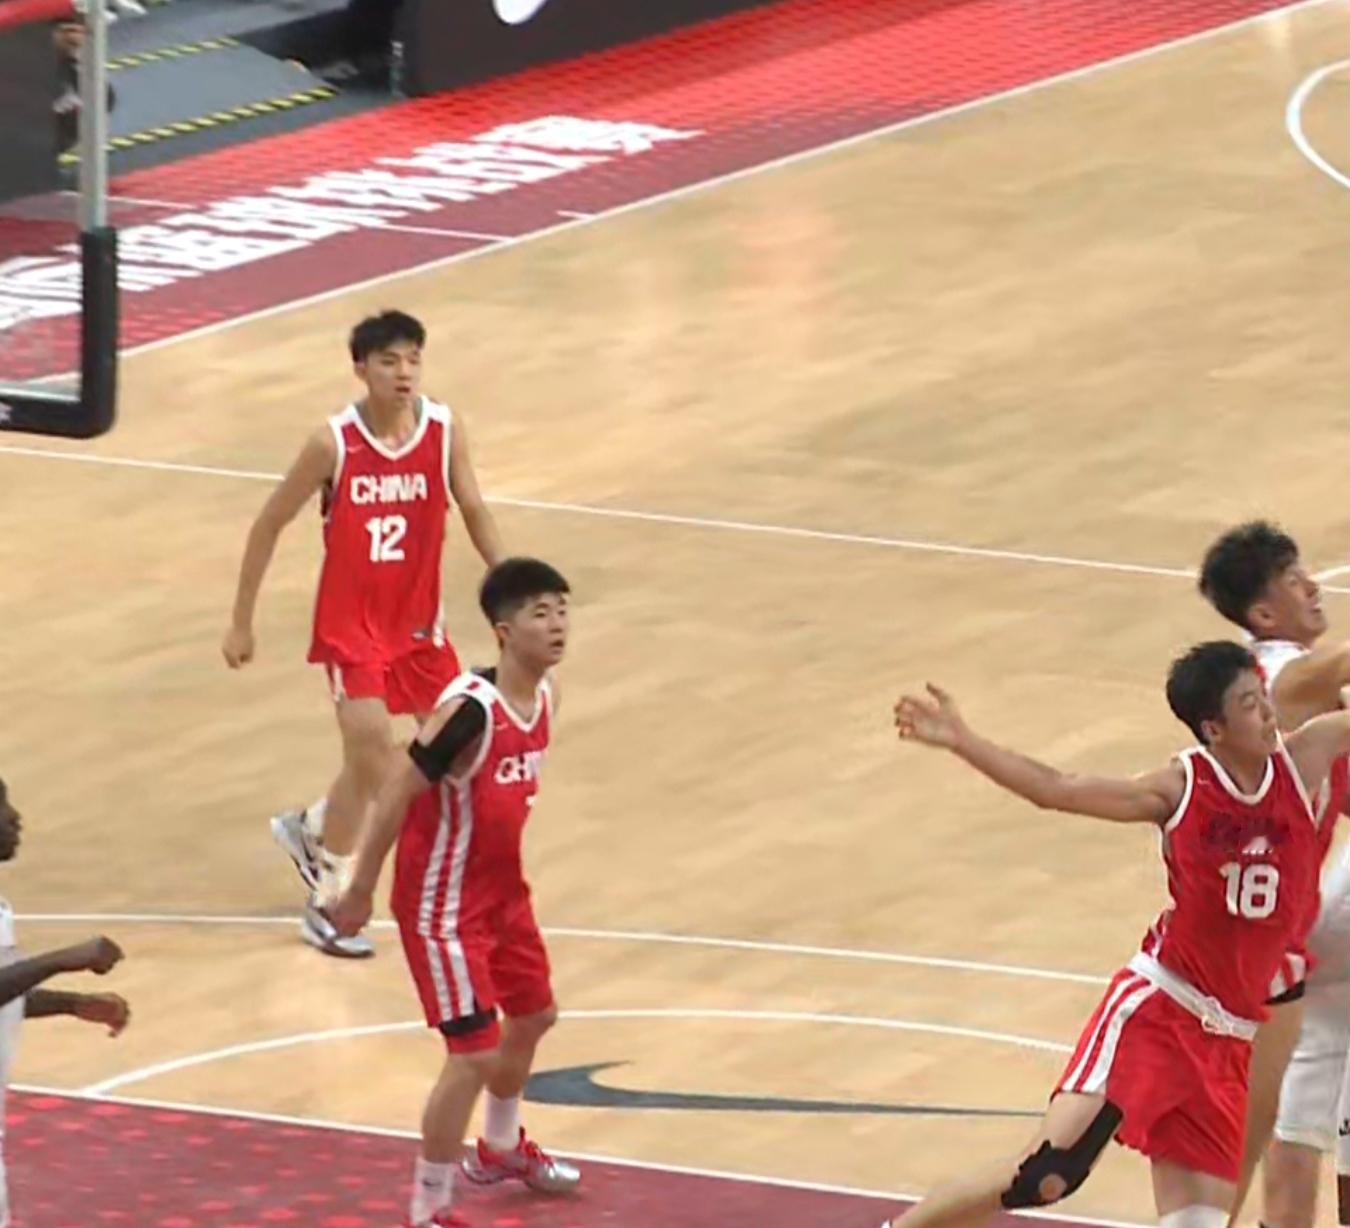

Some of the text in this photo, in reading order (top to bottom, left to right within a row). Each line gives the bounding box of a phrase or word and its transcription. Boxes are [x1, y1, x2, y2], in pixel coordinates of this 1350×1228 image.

[350, 473, 428, 505] CHINA
[365, 515, 407, 562] 12
[1219, 862, 1279, 919] 18
